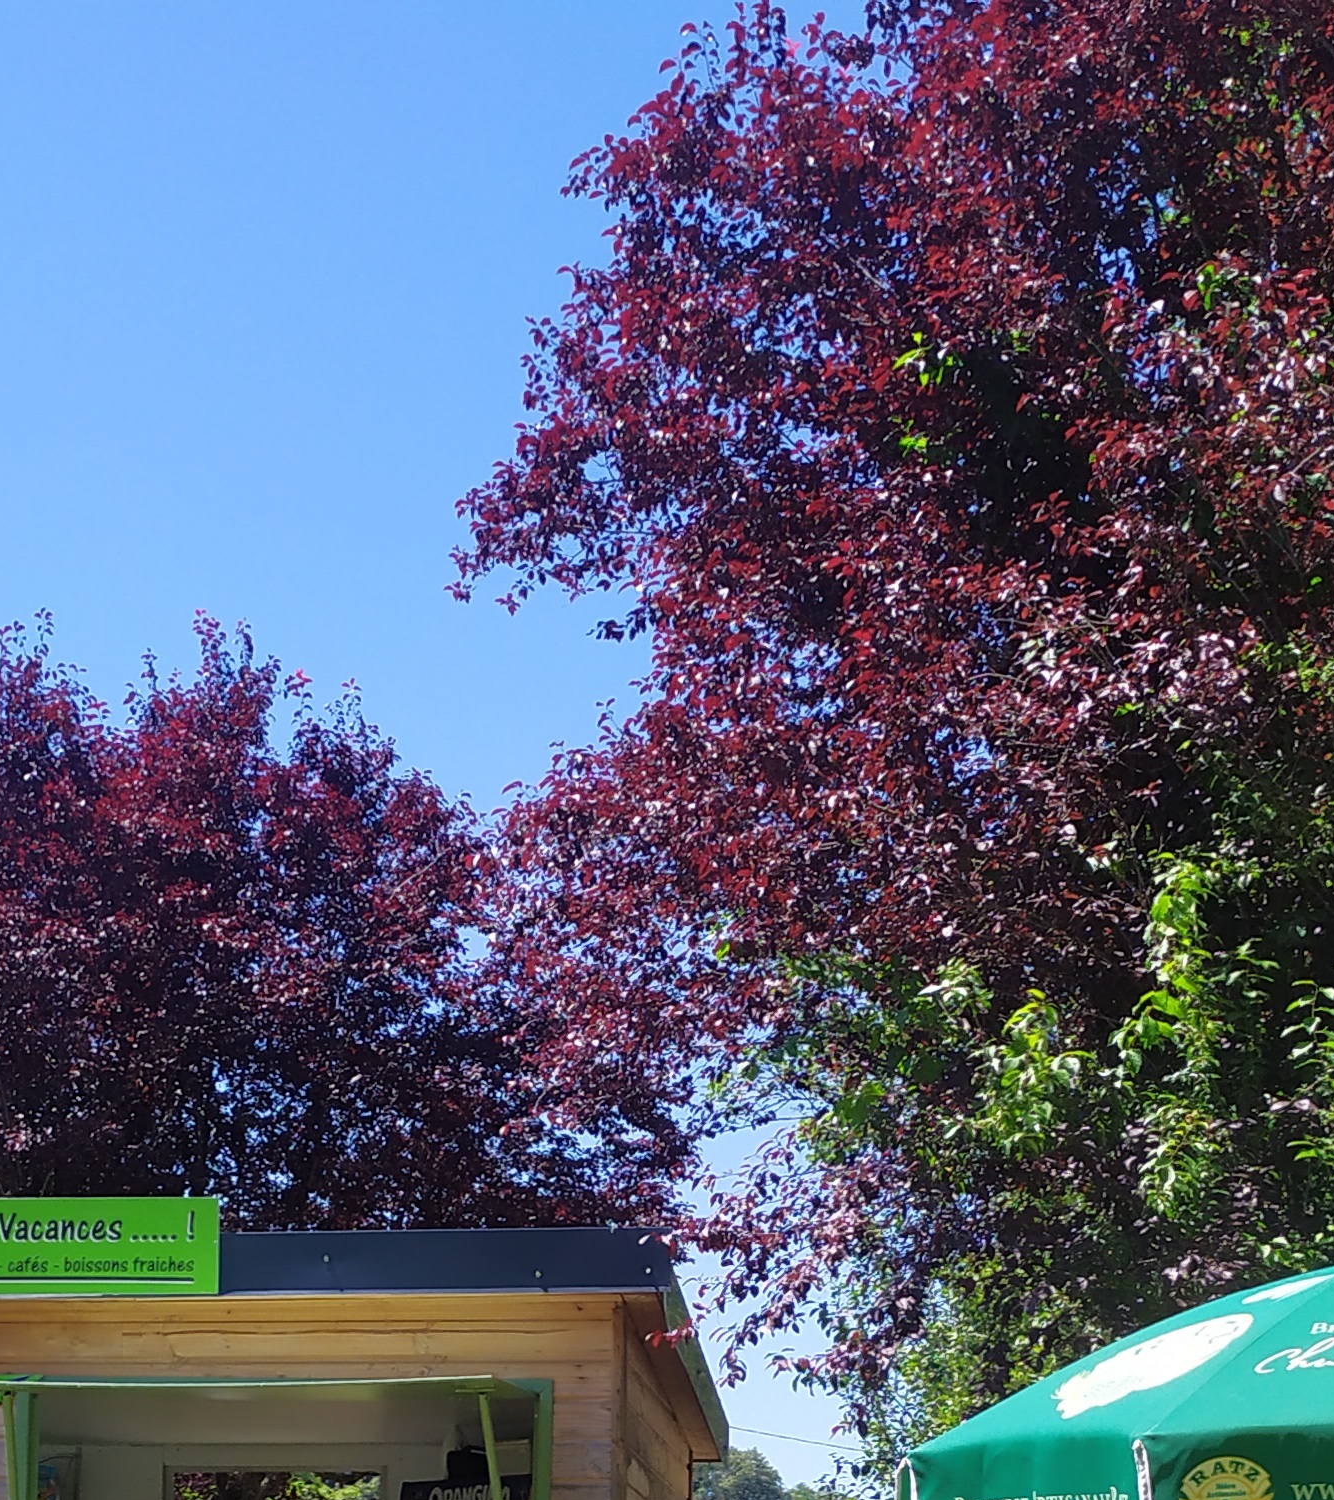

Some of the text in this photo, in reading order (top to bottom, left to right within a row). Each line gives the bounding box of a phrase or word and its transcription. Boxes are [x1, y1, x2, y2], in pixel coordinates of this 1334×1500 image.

[7, 1255, 49, 1274] cafés
[64, 1256, 129, 1274] boissons
[1189, 1460, 1261, 1488] RATZ
